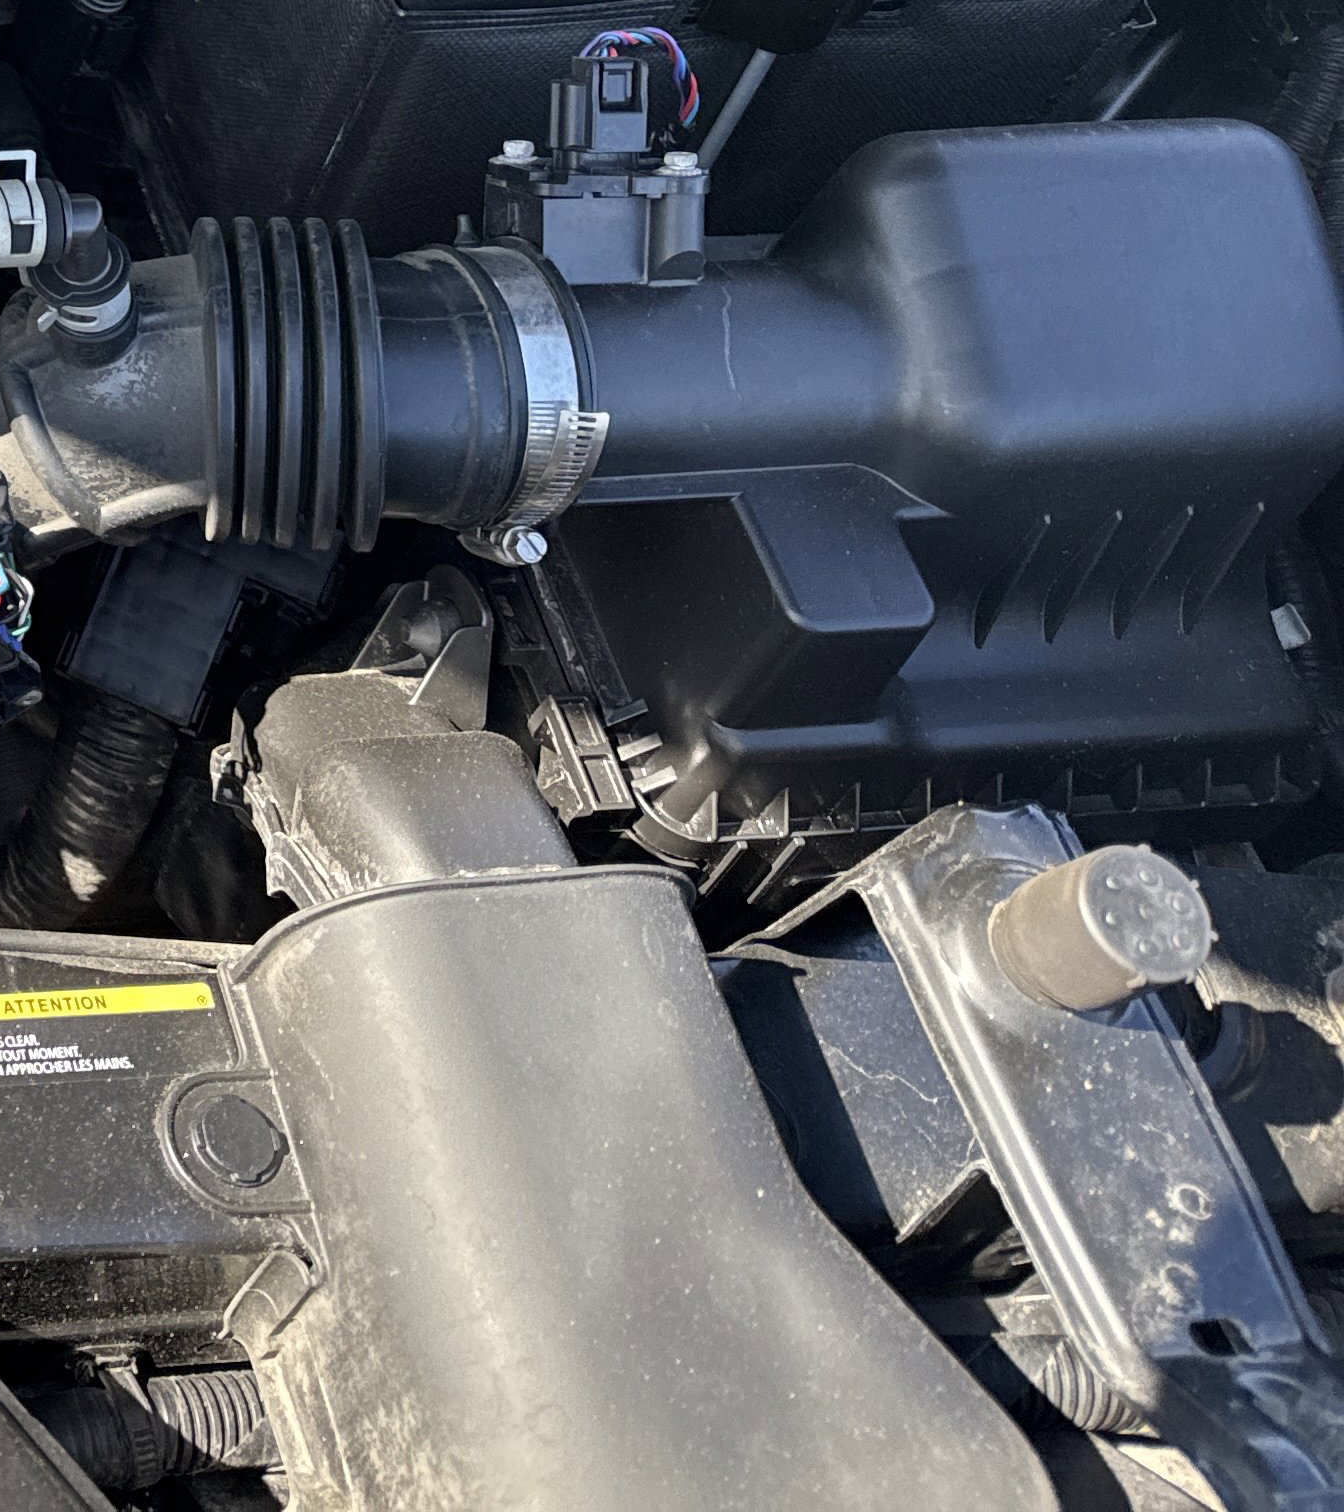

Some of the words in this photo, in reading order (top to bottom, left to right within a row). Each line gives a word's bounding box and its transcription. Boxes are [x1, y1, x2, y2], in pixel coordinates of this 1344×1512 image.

[4, 994, 108, 1015] ATTENTION
[5, 1034, 40, 1048] CLEAR.
[28, 1045, 82, 1060] MOMENT.
[5, 1059, 72, 1076] APPROCHER
[73, 1058, 93, 1072] LES
[94, 1055, 134, 1070] MAINS.
